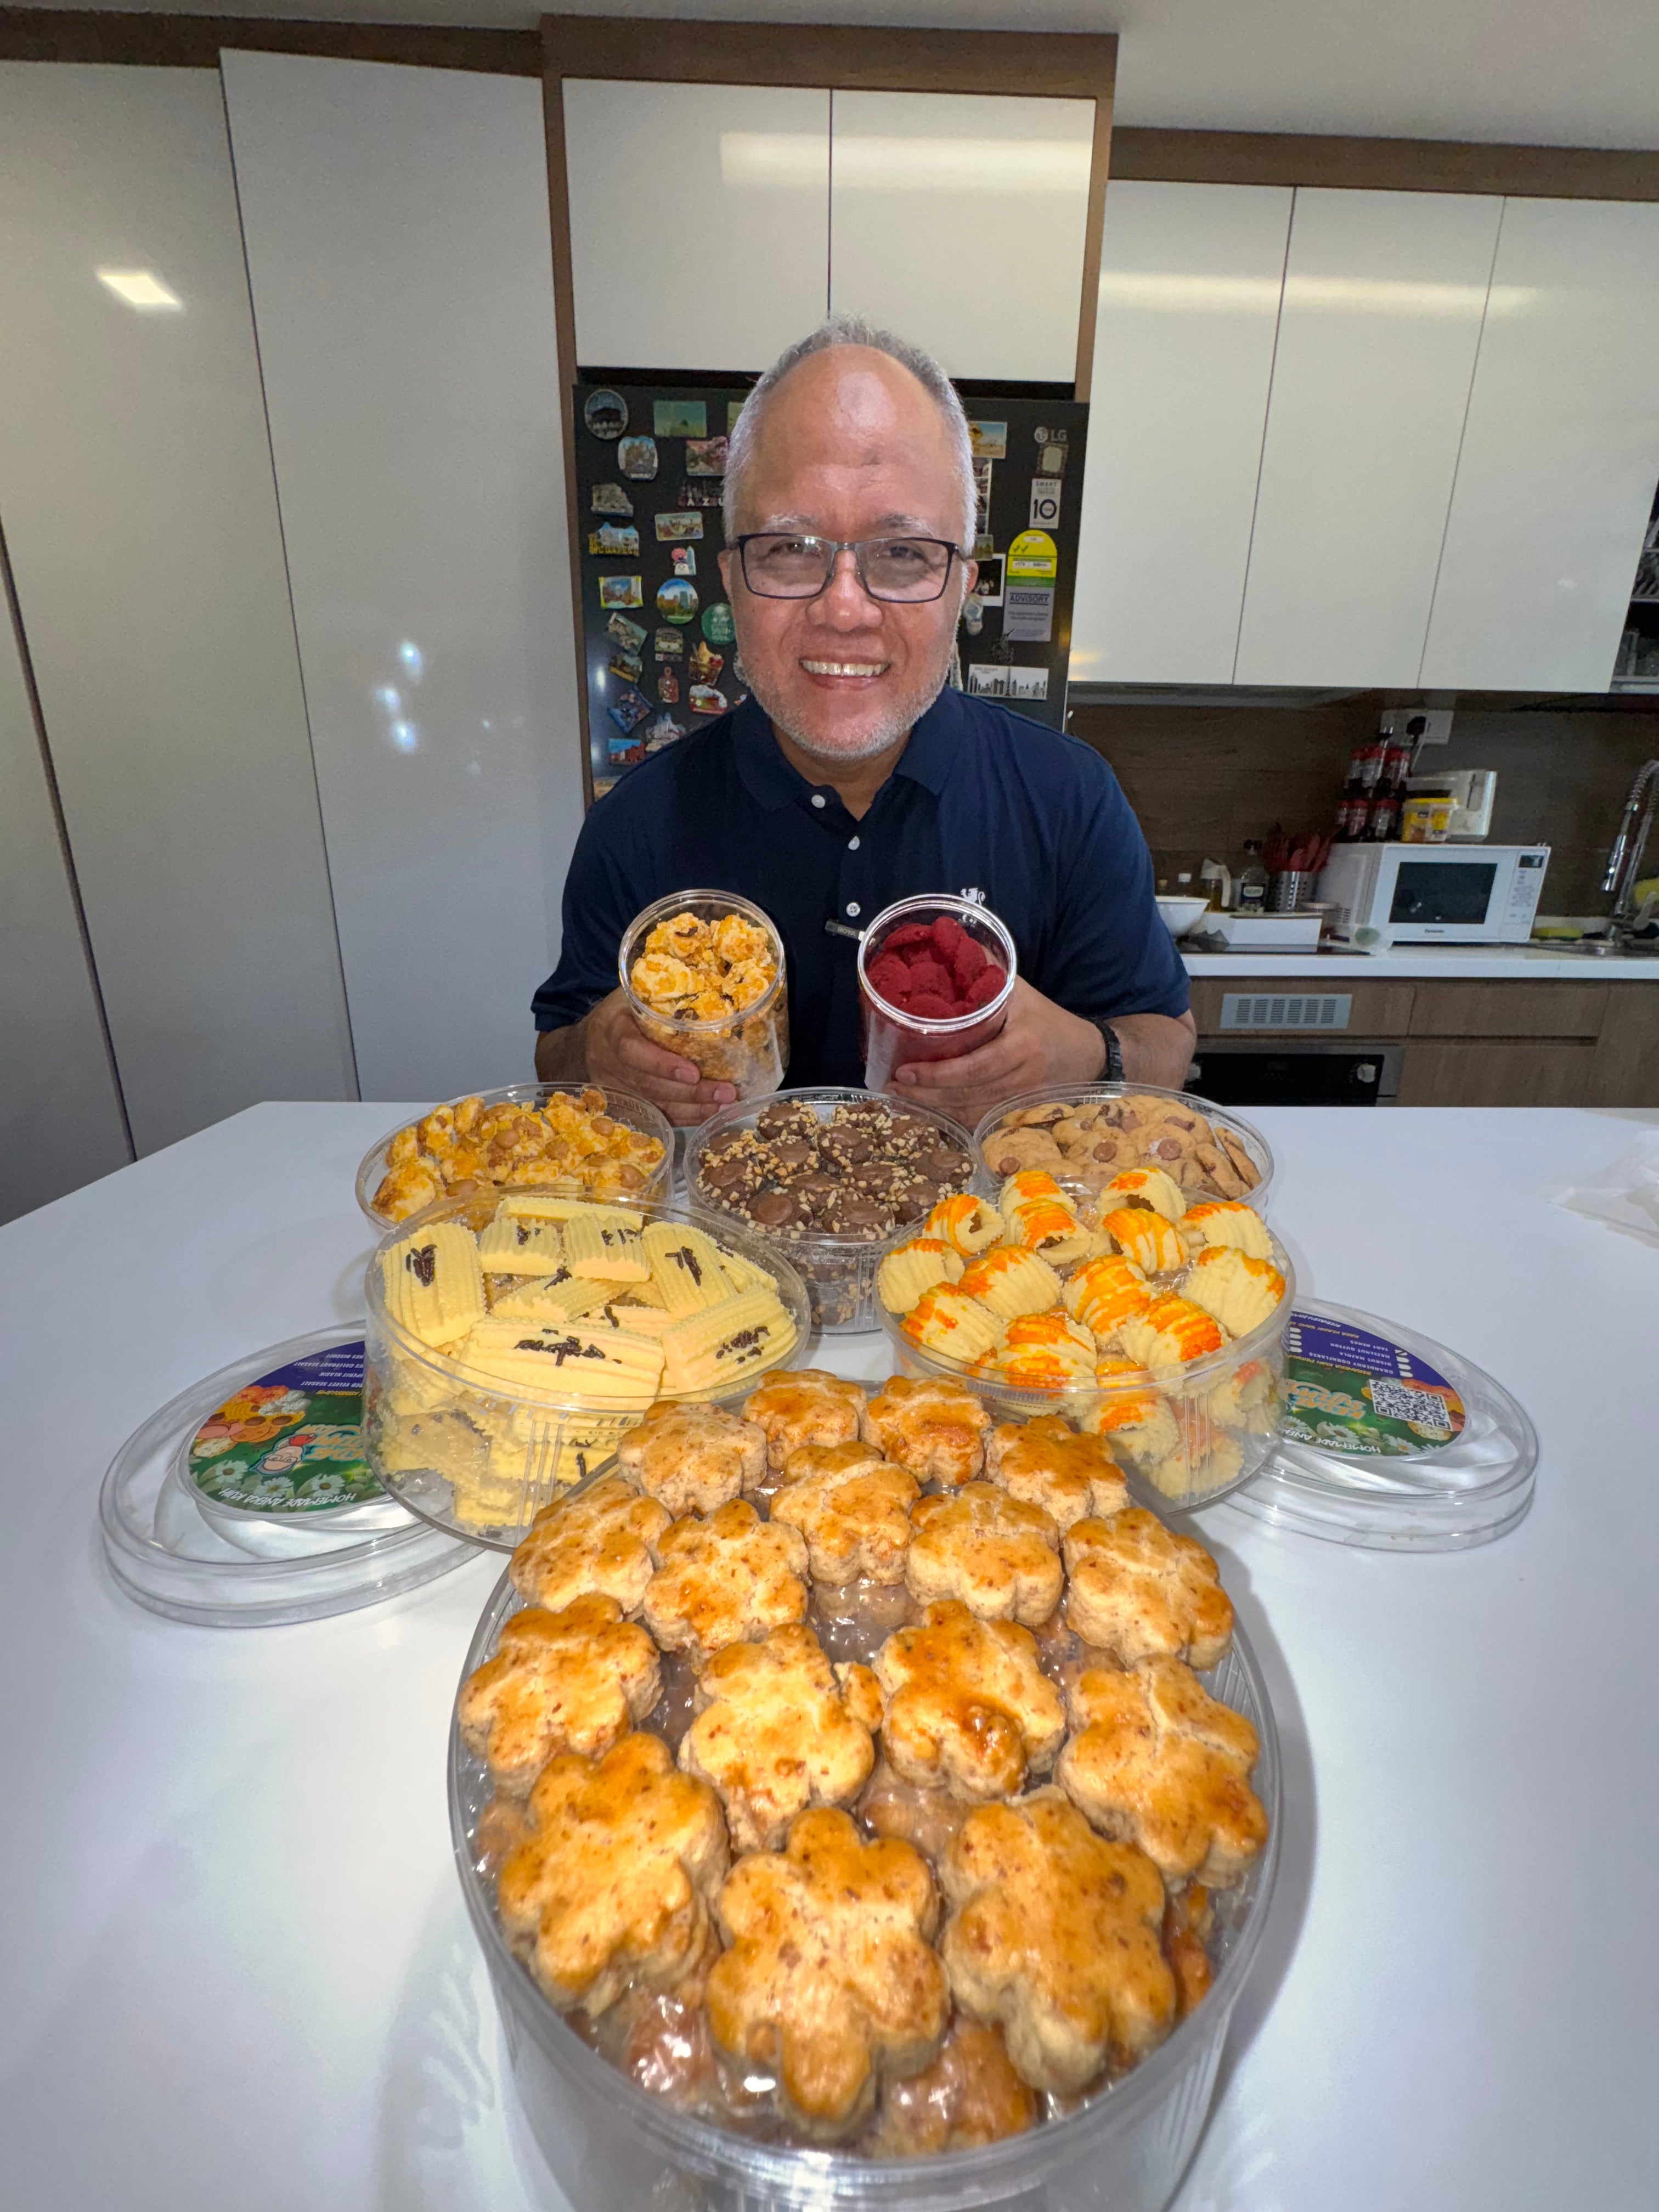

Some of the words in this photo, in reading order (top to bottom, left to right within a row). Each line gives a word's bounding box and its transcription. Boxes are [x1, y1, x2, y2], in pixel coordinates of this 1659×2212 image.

[1051, 430, 1067, 442] LG
[1033, 499, 1057, 520] 10
[1009, 595, 1049, 603] ADVISORY
[837, 926, 856, 937] BOYA
[1330, 1343, 1356, 1352] BUTTON
[1350, 1340, 1371, 1348] NENAS
[1309, 1352, 1351, 1365] CORNFLAKES
[1339, 1352, 1365, 1361] MAZOLA
[1357, 1348, 1390, 1359] HAZELNUT
[1367, 1357, 1392, 1367] BISKUT
[1353, 1363, 1393, 1375] CRANBERRY
[1314, 1437, 1381, 1454] HOMEMADE
[218, 1487, 247, 1501] KUIH
[244, 1494, 286, 1506] ANEKA
[282, 1492, 356, 1506] HOMEMADE
